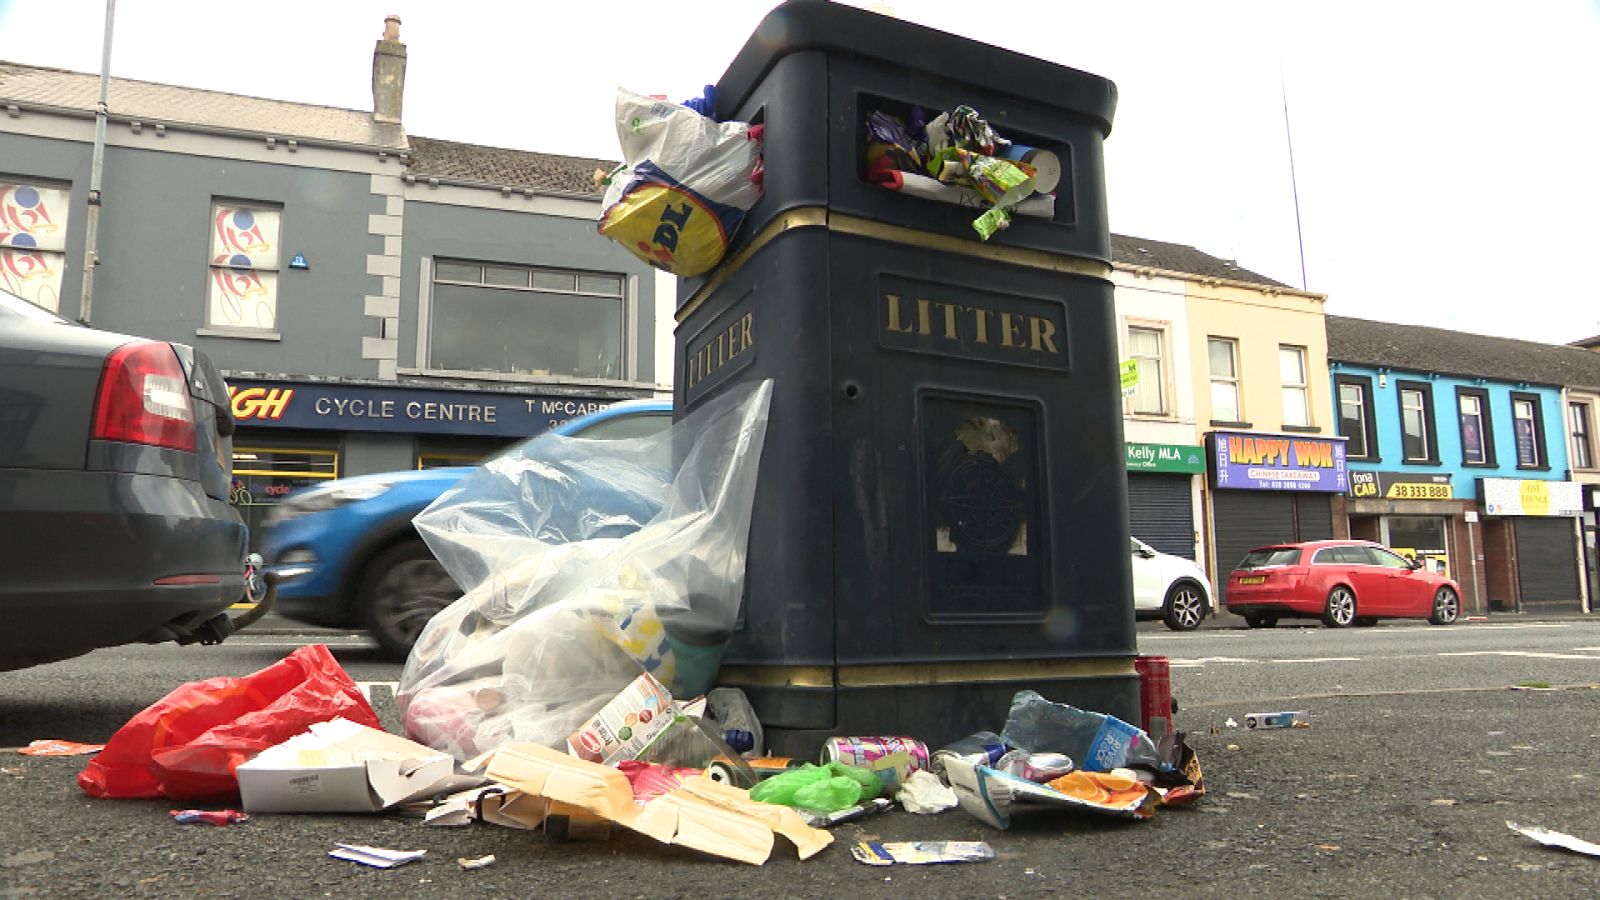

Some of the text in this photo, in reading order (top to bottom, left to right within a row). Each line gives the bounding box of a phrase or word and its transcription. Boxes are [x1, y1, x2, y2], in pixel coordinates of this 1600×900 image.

[886, 293, 1059, 354] LITTER
[688, 312, 754, 390] LITTER
[315, 397, 394, 419] CYCLE
[405, 401, 498, 424] CENTRE
[524, 399, 536, 413] T
[1127, 446, 1182, 462] Kelly MLA
[1228, 436, 1335, 469] HAPPY WOK
[1249, 469, 1318, 481] CHINESE TAKEAWAY
[1352, 472, 1374, 484] fona
[1354, 482, 1377, 497] CAB
[1395, 485, 1449, 498] 38 333 888
[1521, 494, 1549, 504] LOUNGE
